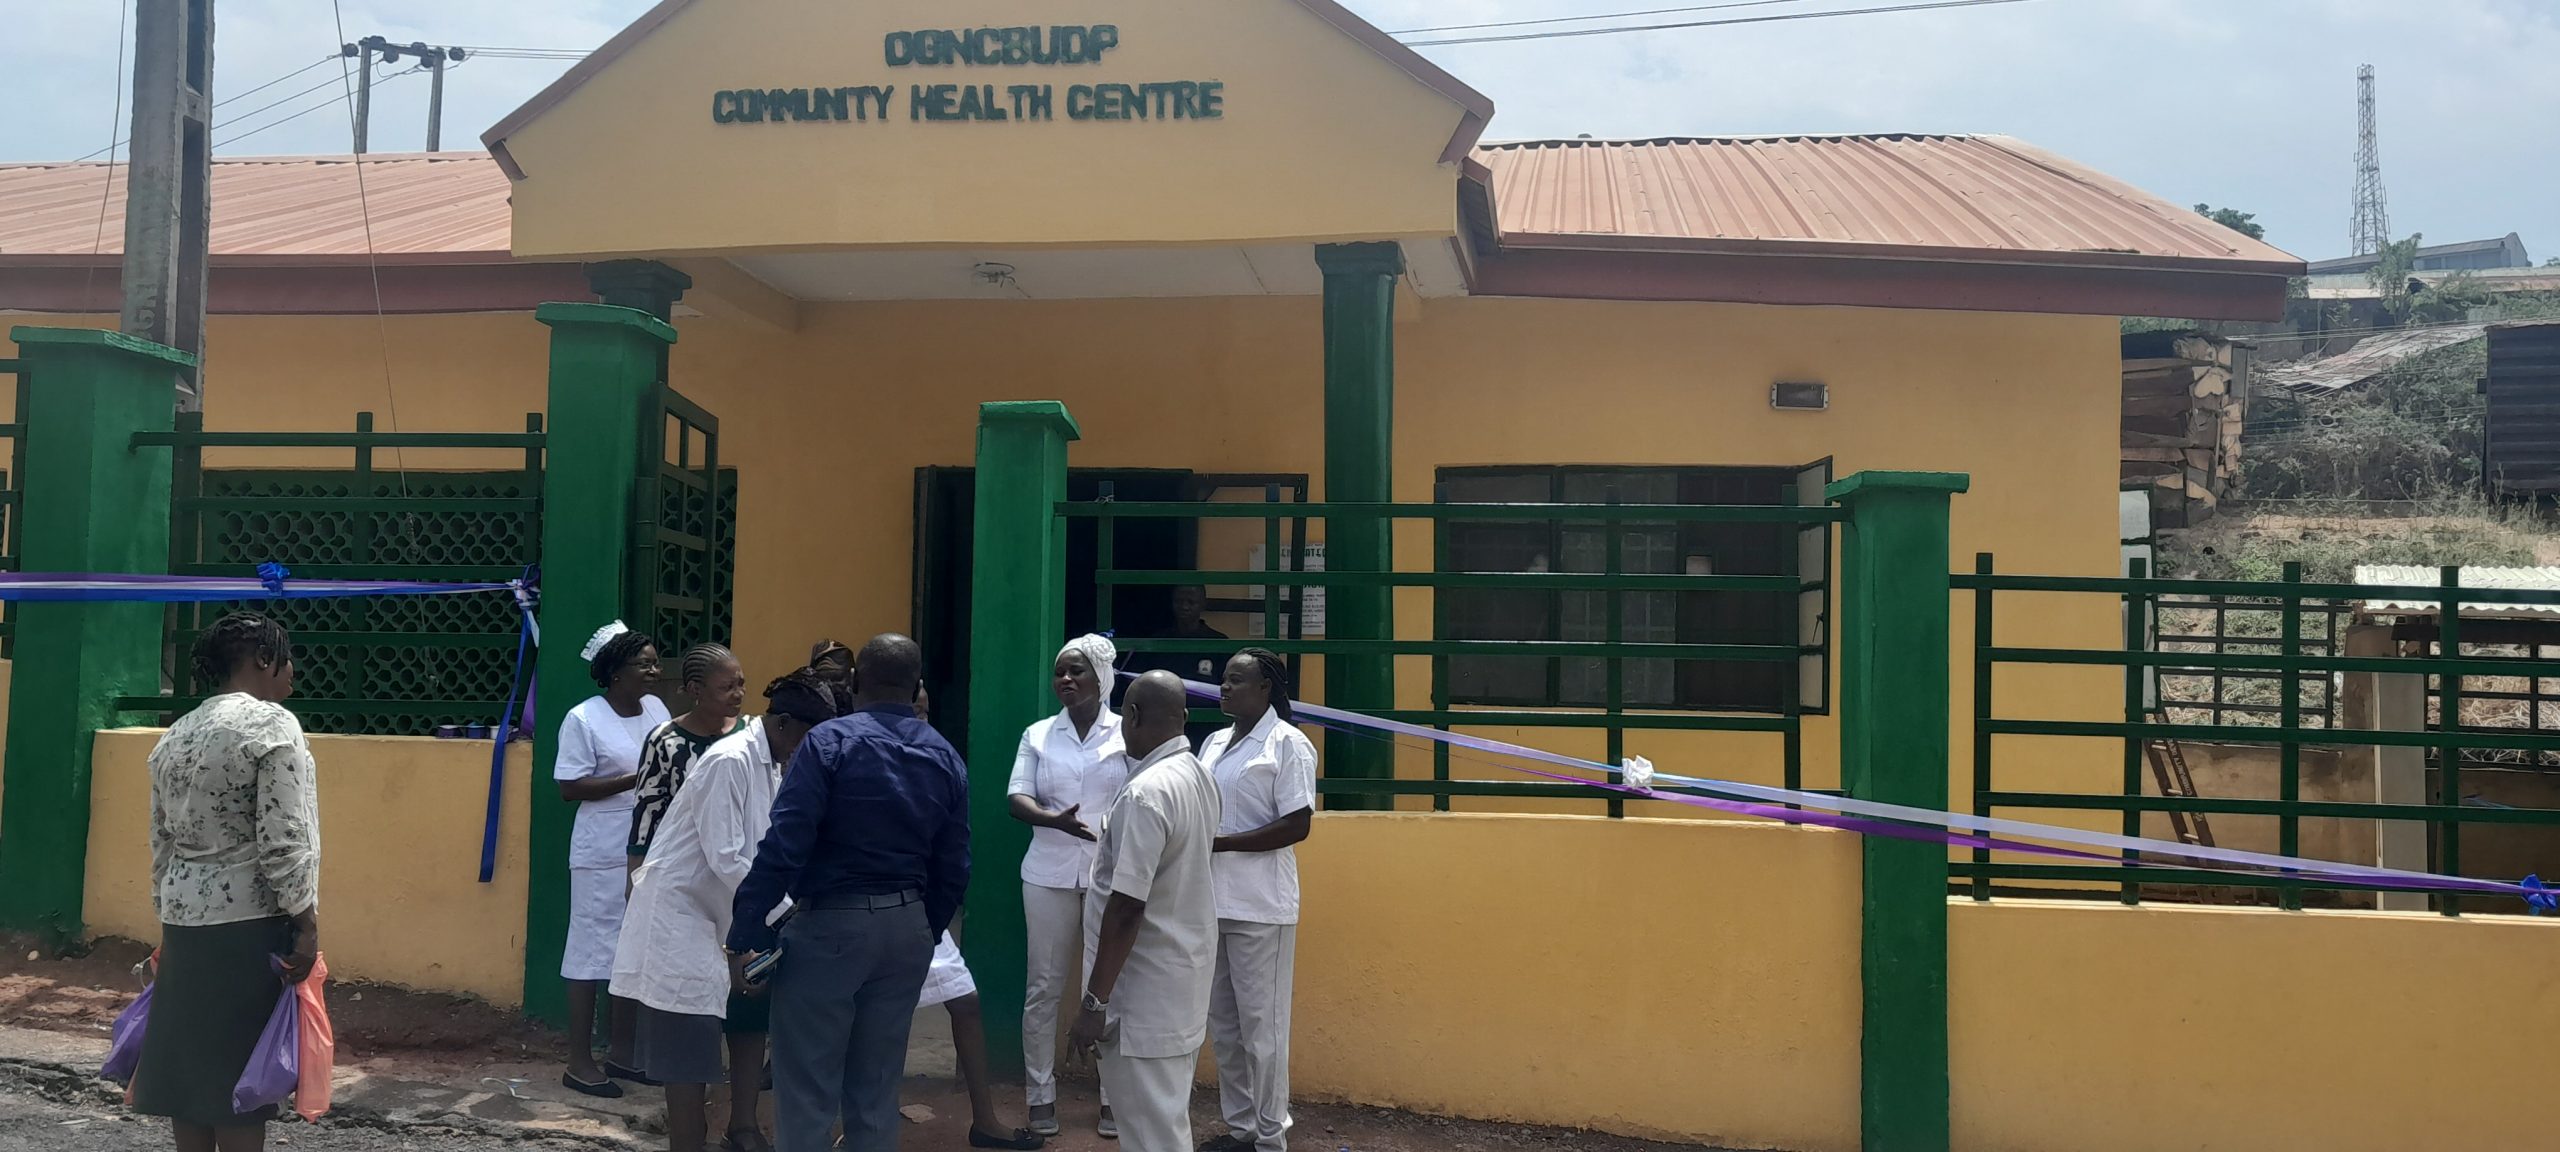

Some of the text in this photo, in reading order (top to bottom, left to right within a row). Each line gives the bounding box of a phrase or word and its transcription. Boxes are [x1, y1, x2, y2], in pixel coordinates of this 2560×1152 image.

[713, 80, 1223, 124] COMMUNITY HEALTH CENTRE
